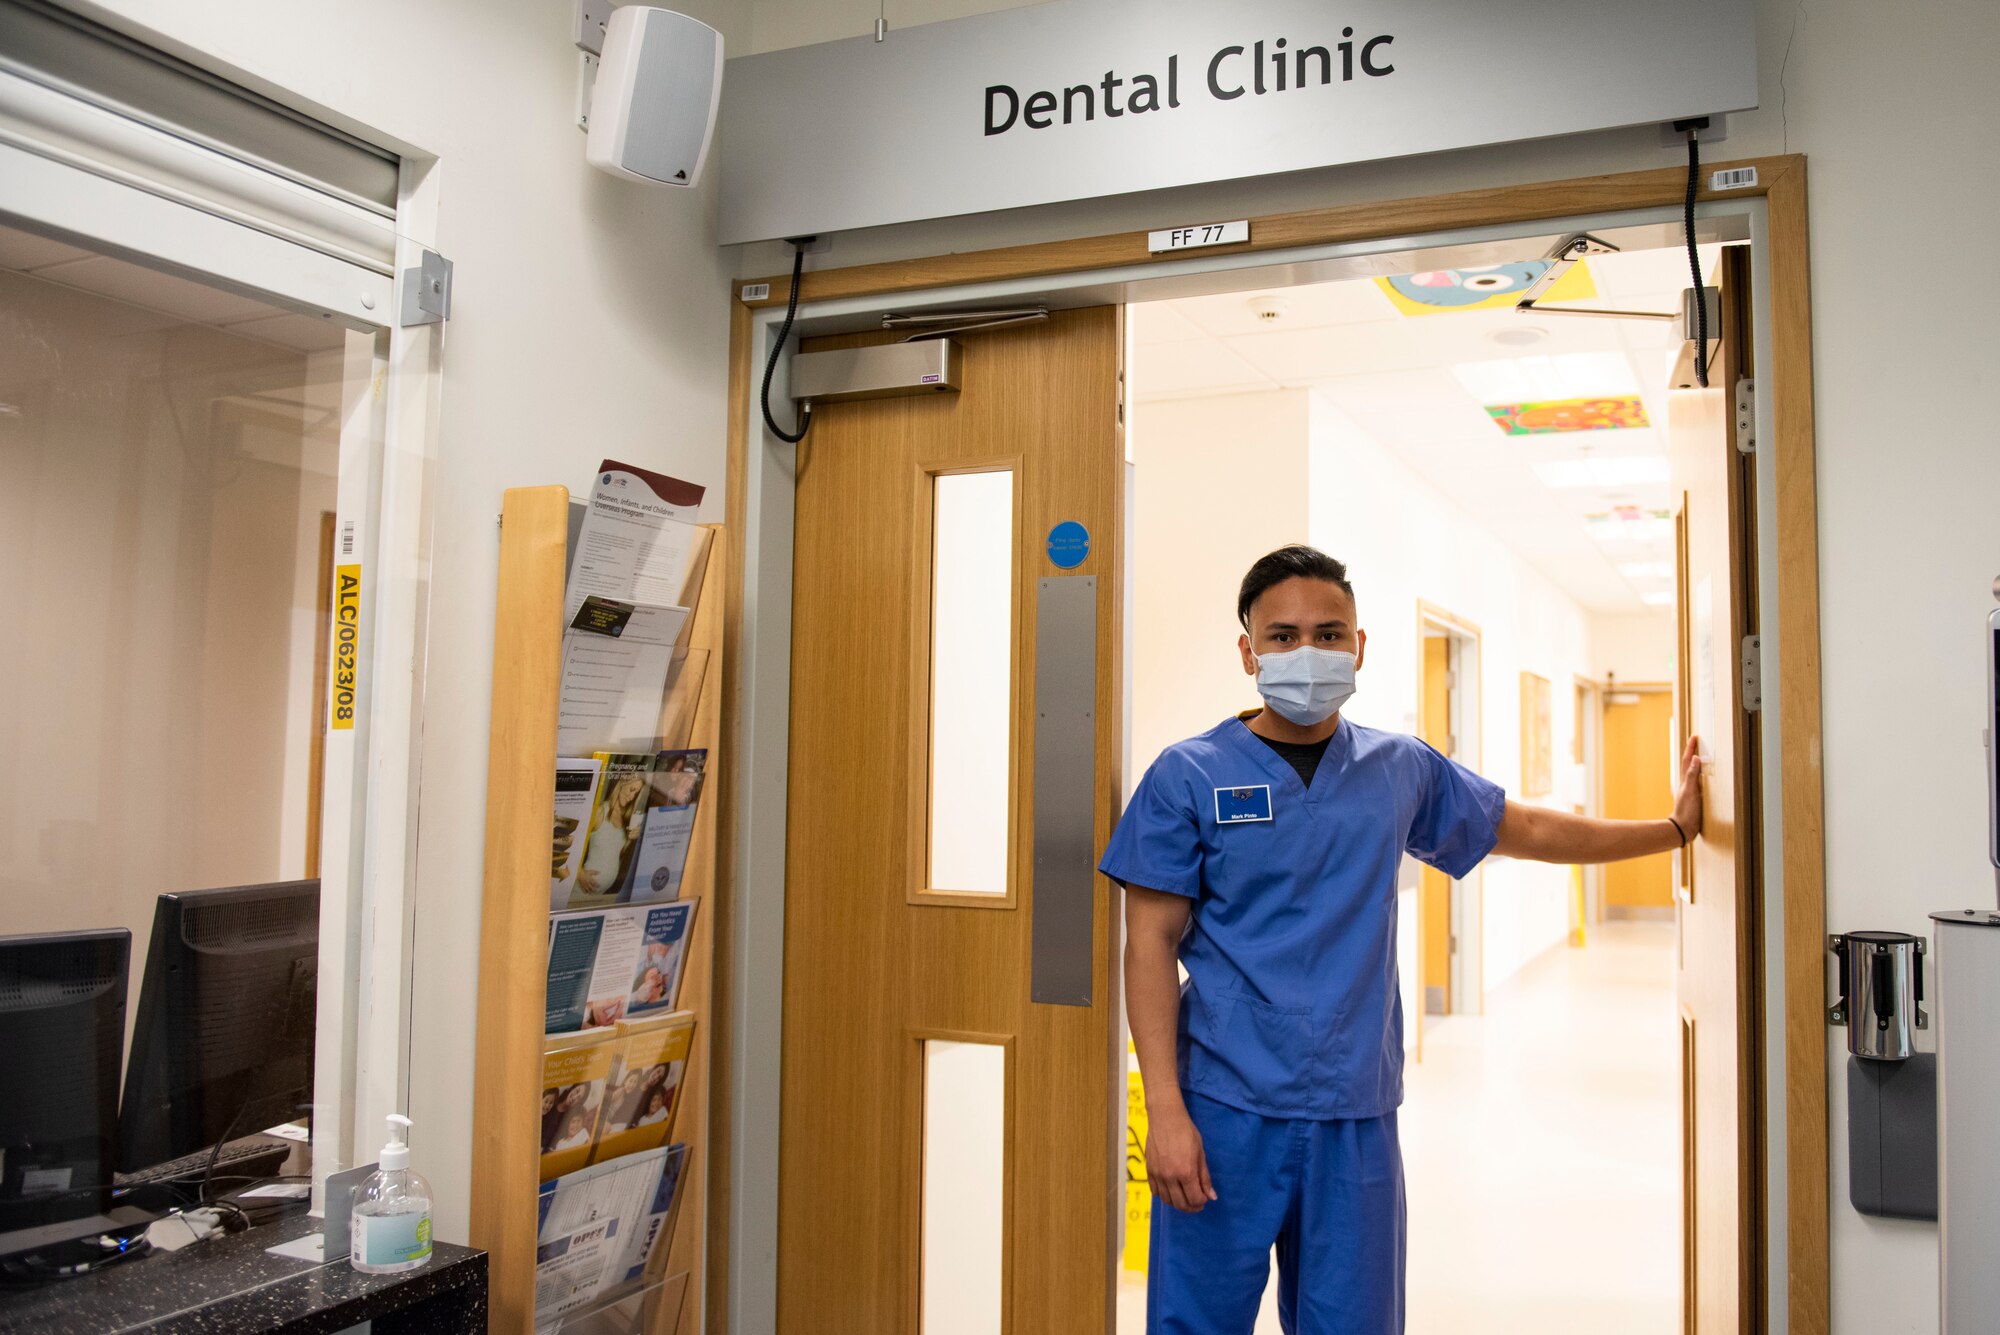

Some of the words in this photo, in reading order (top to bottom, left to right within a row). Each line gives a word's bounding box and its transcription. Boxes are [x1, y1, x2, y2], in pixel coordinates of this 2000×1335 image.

[984, 54, 1181, 137] Dental
[1206, 26, 1396, 101] Clinic
[1171, 229, 1194, 247] FF
[1202, 225, 1225, 243] 77
[594, 501, 620, 513] Overseas
[621, 507, 645, 518] Program
[596, 492, 619, 505] Women,
[620, 498, 640, 511] Infants,
[641, 504, 653, 512] and
[652, 505, 675, 517] Children
[336, 574, 358, 720] ALC/0623/08
[609, 762, 637, 773] Pregnancy
[637, 763, 649, 771] and
